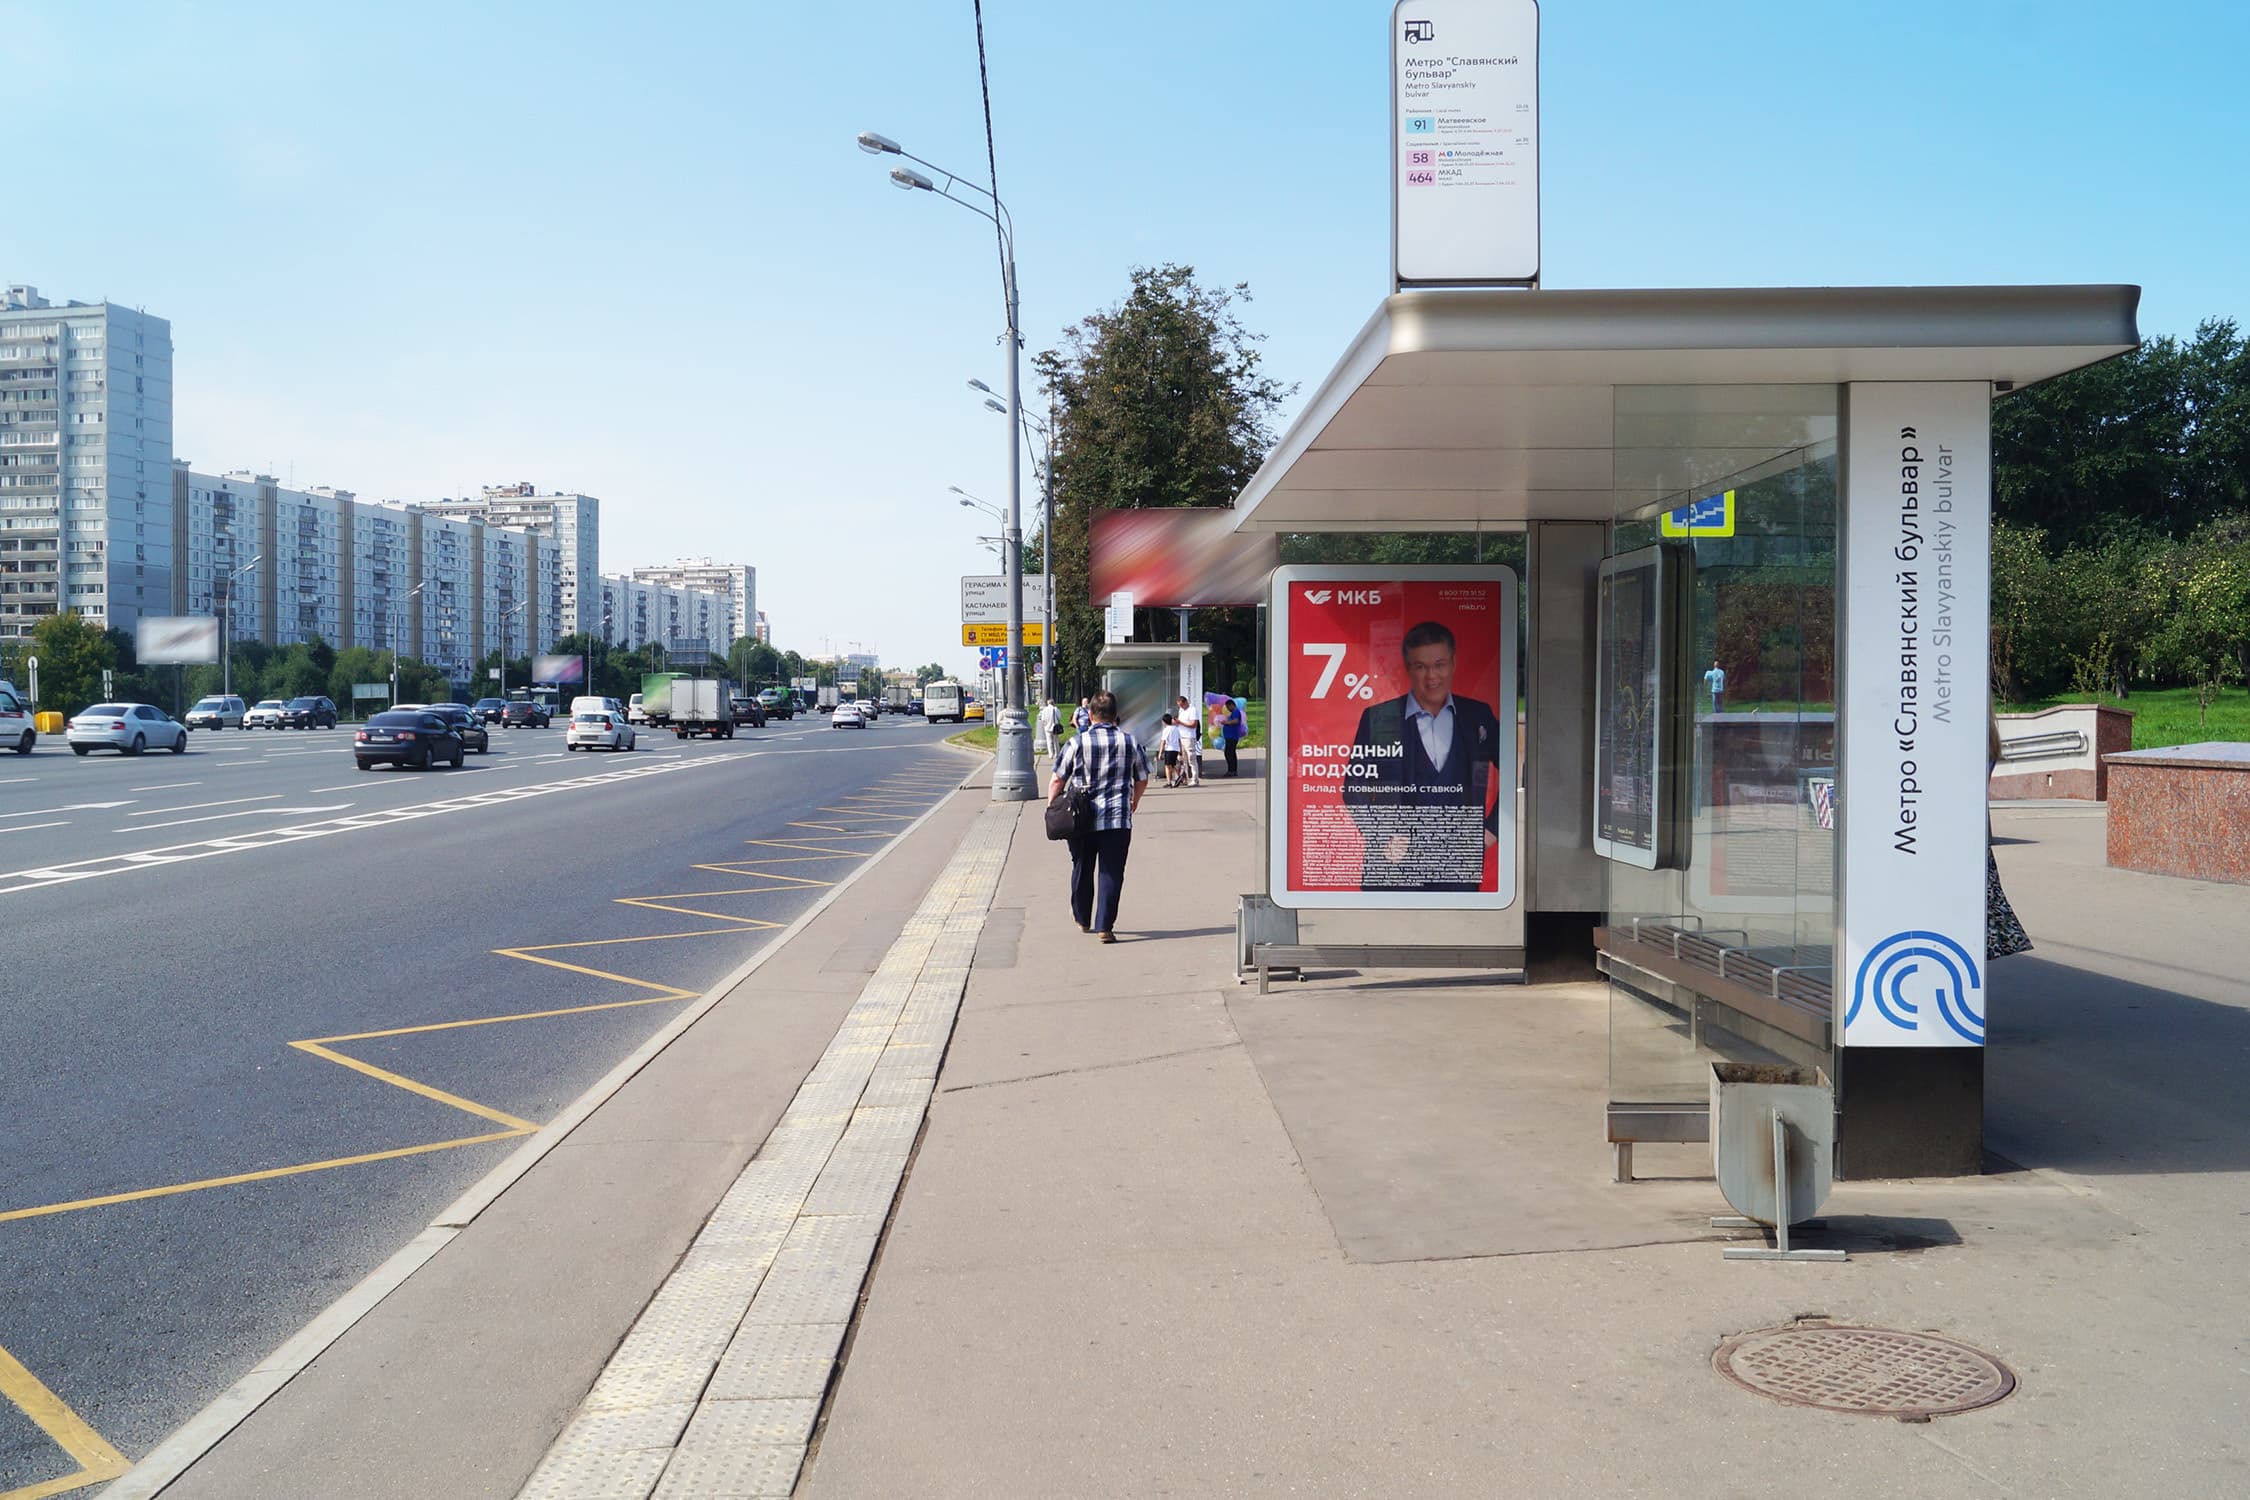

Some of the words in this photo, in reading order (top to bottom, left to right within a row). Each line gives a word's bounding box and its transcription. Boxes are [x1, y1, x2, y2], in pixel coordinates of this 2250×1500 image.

[1405, 58, 1443, 68] Метро
[1446, 56, 1518, 66] "Славянский
[1405, 69, 1457, 80] бульвар"
[1413, 119, 1426, 130] 91
[1412, 153, 1429, 164] 58
[1409, 172, 1433, 184] 464
[1932, 444, 1952, 513] bulvar
[1932, 520, 1956, 647] Slavyanskiy
[1338, 590, 1382, 605] МКБ
[1894, 571, 1918, 752] «Славянский
[1932, 654, 1951, 724] Metro
[1301, 741, 1404, 759] ВЫГОДНЫЙ
[1301, 763, 1379, 778] ПОДХОД
[1302, 784, 1336, 794] Вклад
[1339, 785, 1346, 793] с
[1348, 783, 1417, 793] повышенной
[1419, 783, 1464, 793] ставкой
[1894, 760, 1922, 855] Метро
